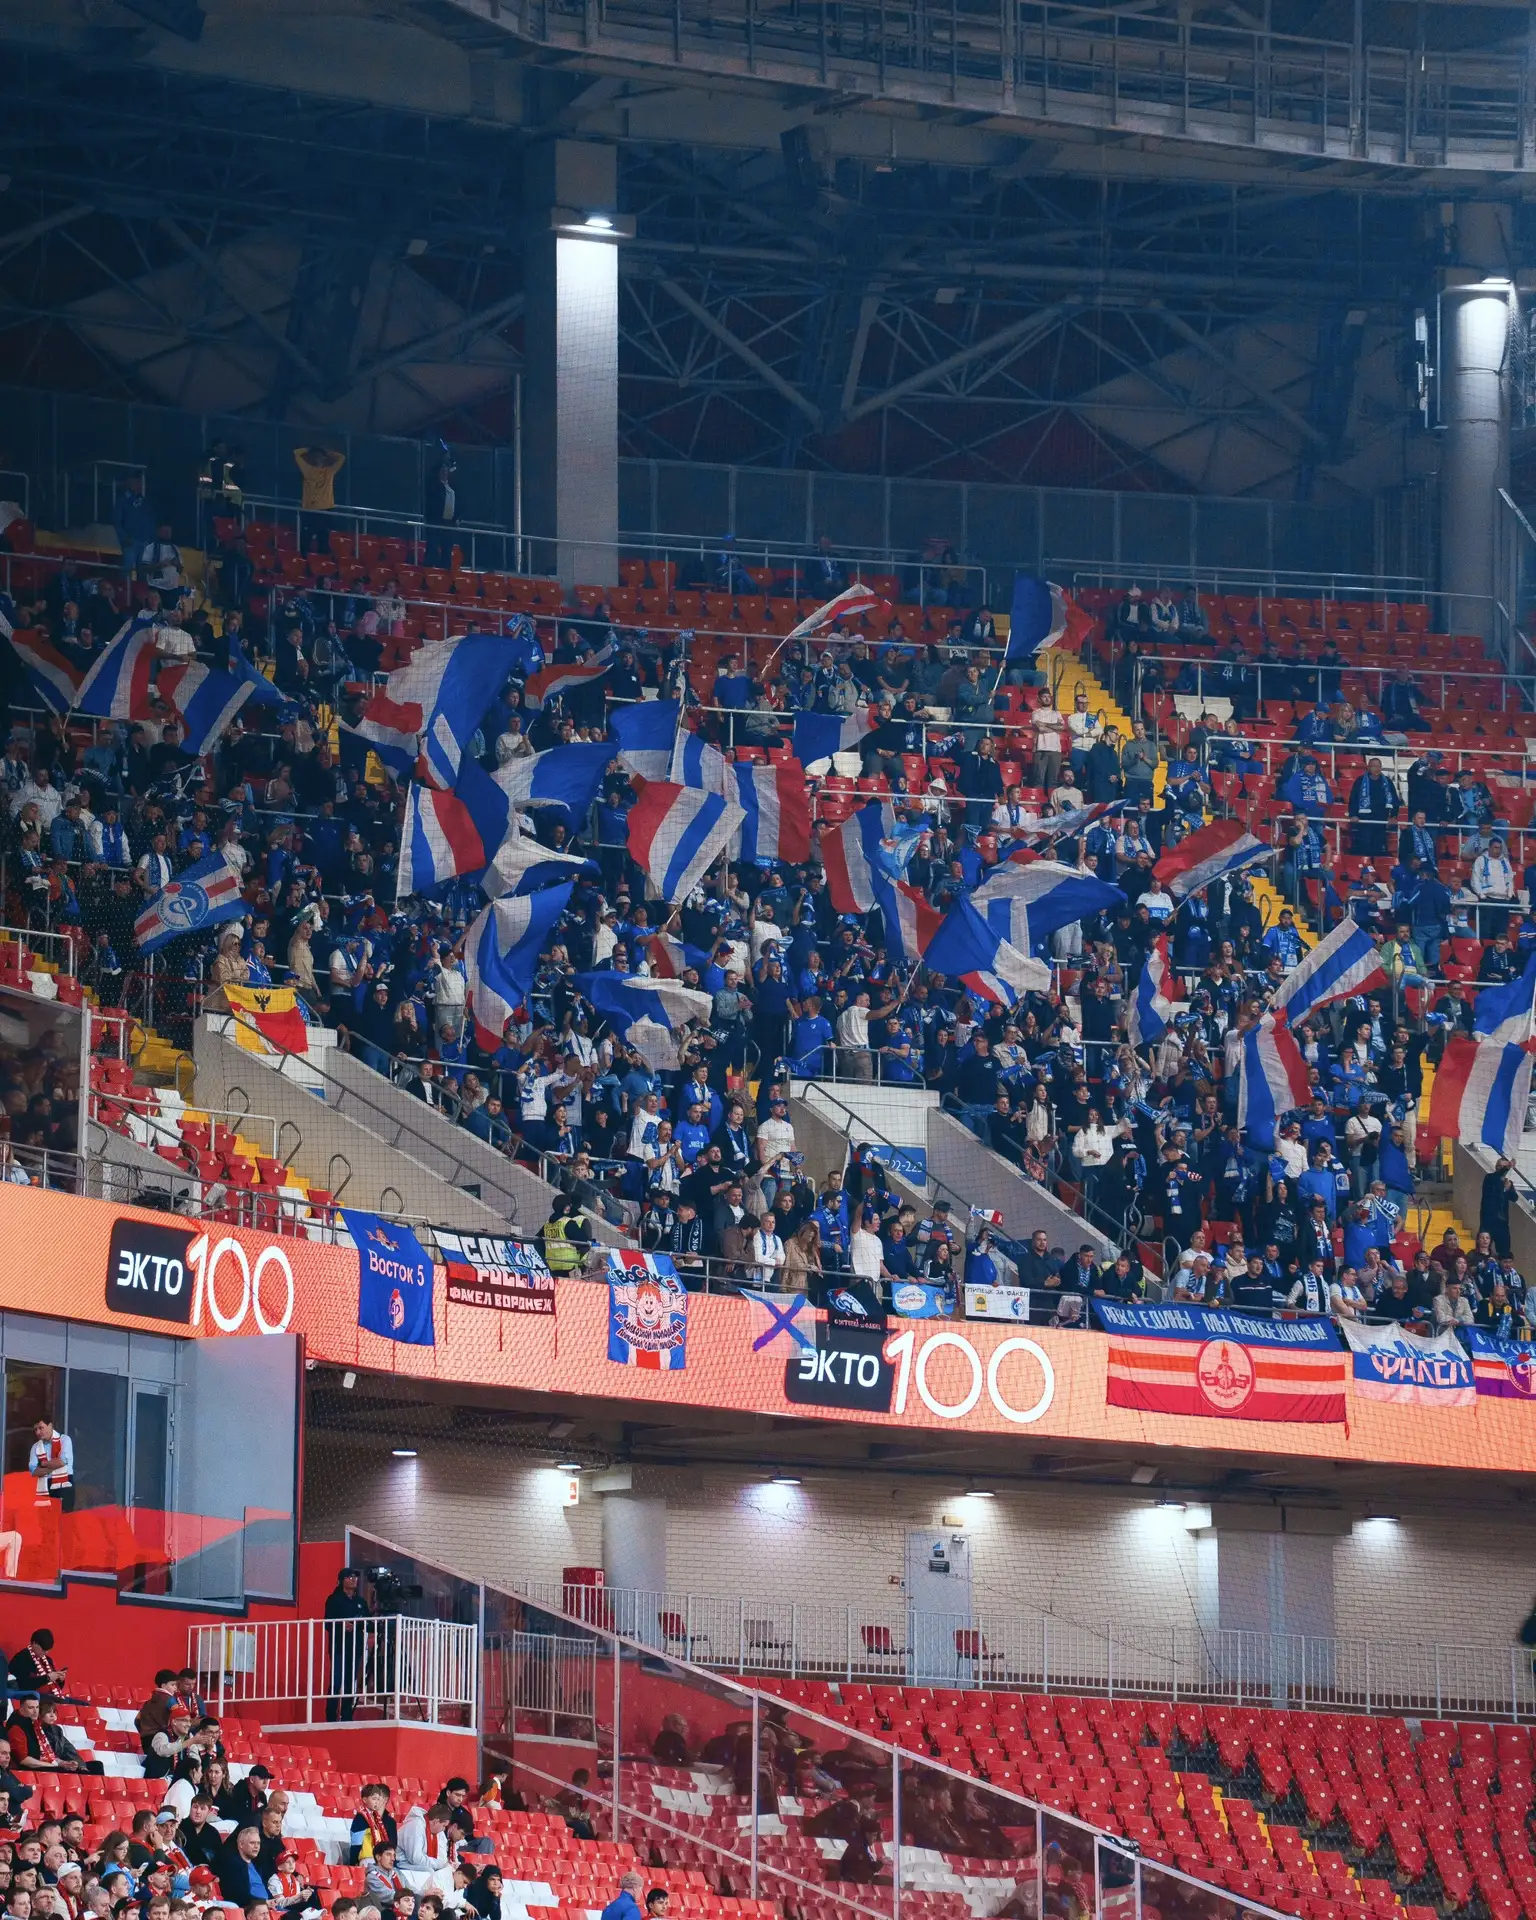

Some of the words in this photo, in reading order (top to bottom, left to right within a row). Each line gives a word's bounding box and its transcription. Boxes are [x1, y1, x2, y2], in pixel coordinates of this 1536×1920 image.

[117, 1250, 184, 1296] ЭКТО
[186, 1234, 295, 1335] 100
[417, 1264, 425, 1287] 5
[470, 1262, 555, 1291] РОССИЯ
[666, 1279, 679, 1293] 5
[449, 1286, 492, 1306] ФАКЕЛ
[494, 1293, 552, 1312] ВОРОНЕЖ
[1101, 1305, 1141, 1328] ПОКА
[1138, 1310, 1195, 1330] ЕДИНЫ
[1201, 1312, 1232, 1333] МЫ
[798, 1348, 880, 1388] ЭКТО
[886, 1330, 1055, 1423] 100
